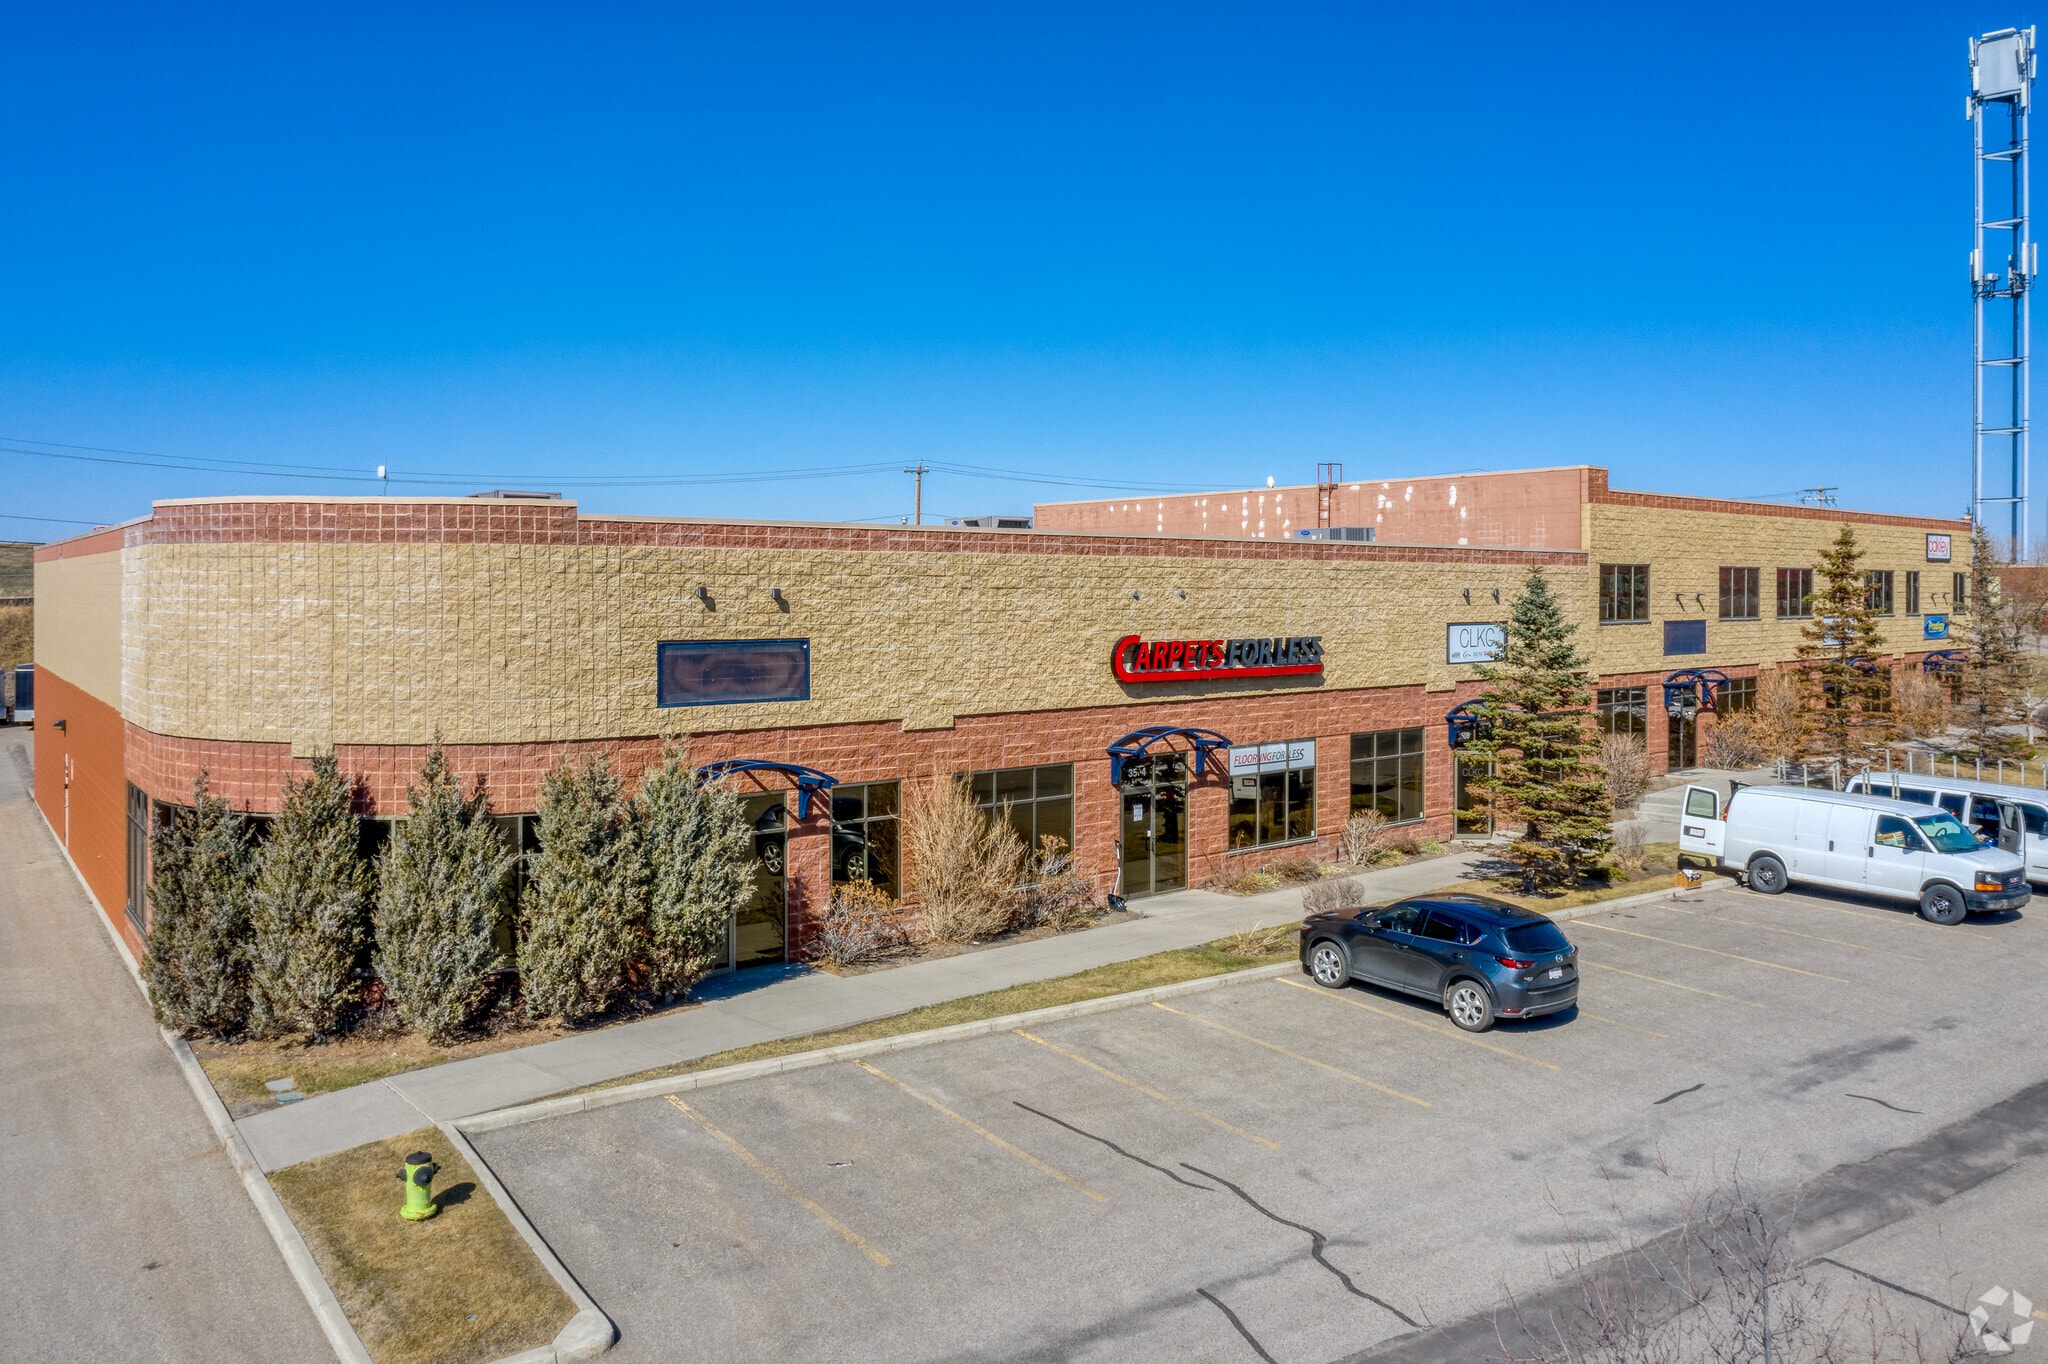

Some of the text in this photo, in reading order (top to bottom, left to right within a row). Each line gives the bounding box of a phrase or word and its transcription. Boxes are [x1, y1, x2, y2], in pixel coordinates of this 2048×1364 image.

[1112, 634, 1324, 683] CARPETS FOR LESS
[1234, 748, 1304, 765] FLOORING FOR LESS
[1128, 767, 1146, 778] 354
